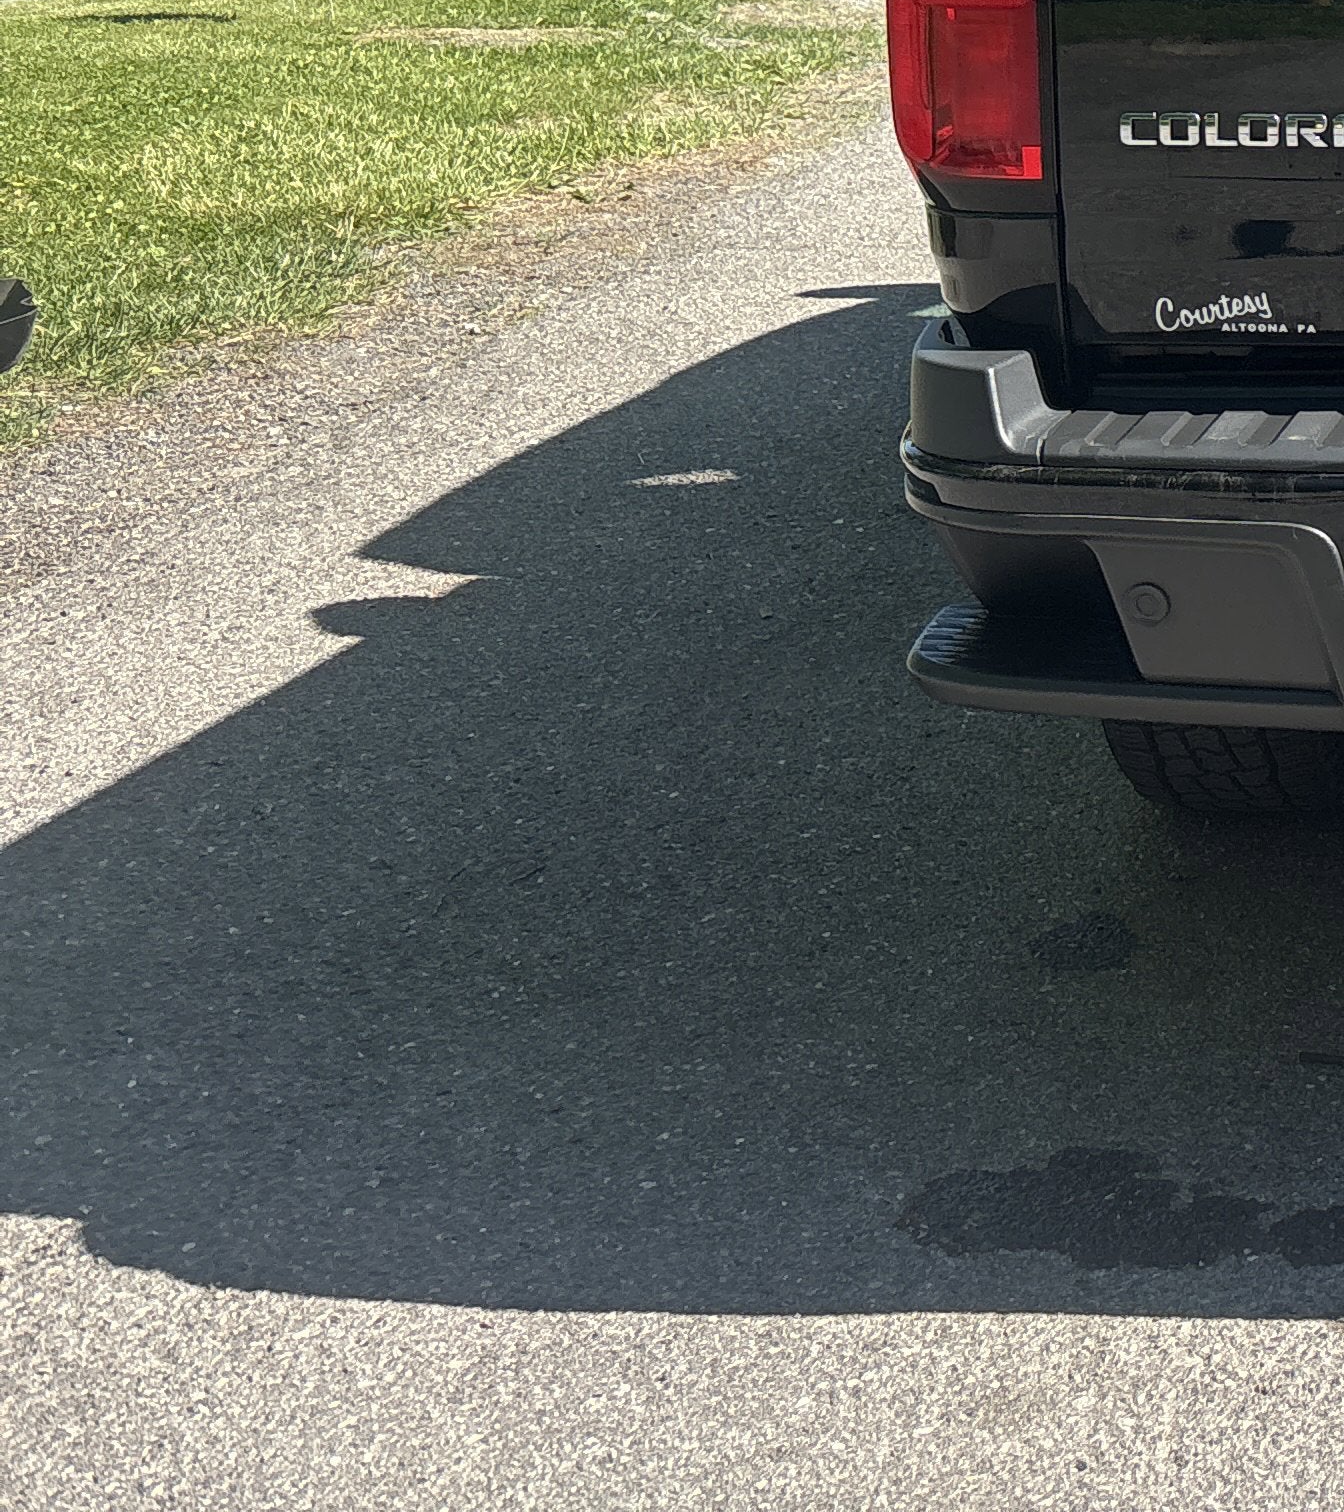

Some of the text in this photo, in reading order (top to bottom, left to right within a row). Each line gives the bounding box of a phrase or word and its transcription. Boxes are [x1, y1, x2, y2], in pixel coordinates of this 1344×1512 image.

[1155, 291, 1273, 332] Courtesy
[1220, 322, 1317, 334] ALTOONA PA
